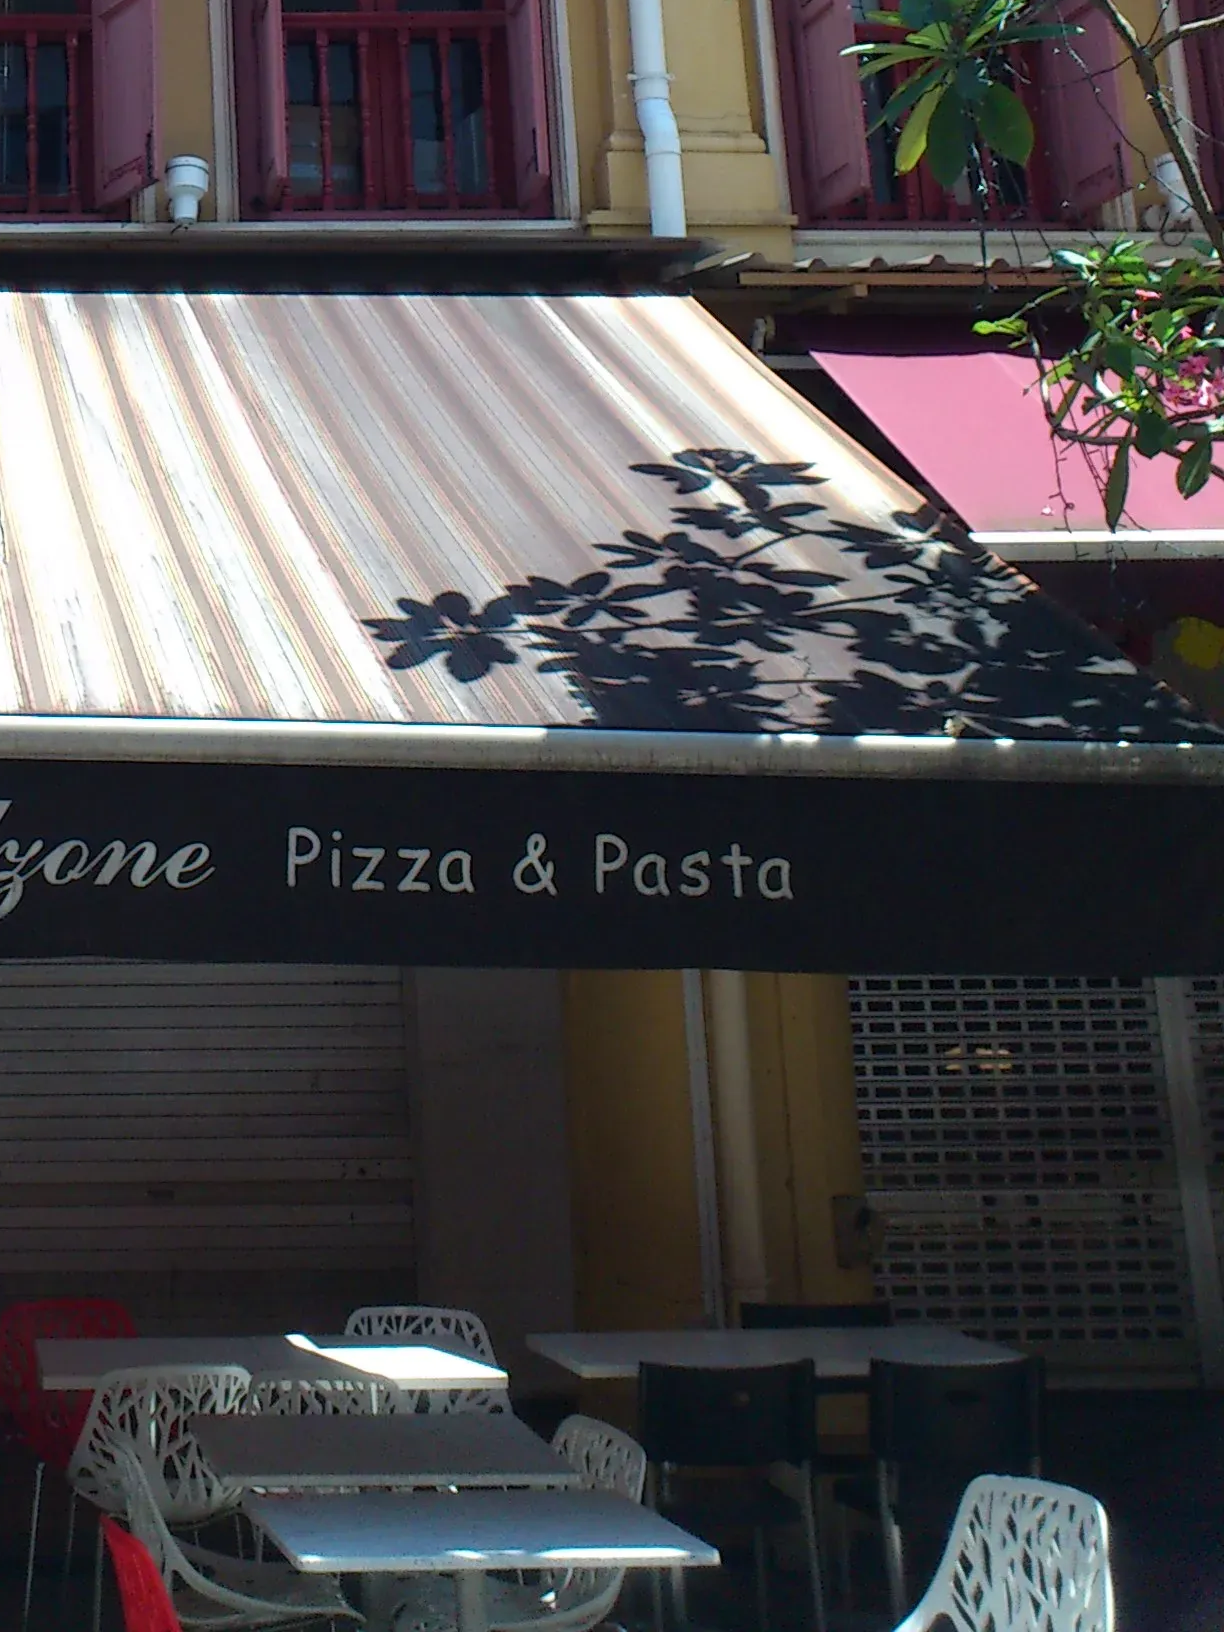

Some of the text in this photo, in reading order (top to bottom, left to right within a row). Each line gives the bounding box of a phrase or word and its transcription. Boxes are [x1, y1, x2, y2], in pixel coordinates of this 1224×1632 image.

[285, 826, 474, 894] Pizza
[512, 832, 558, 896] &
[594, 832, 793, 900] Pasta
